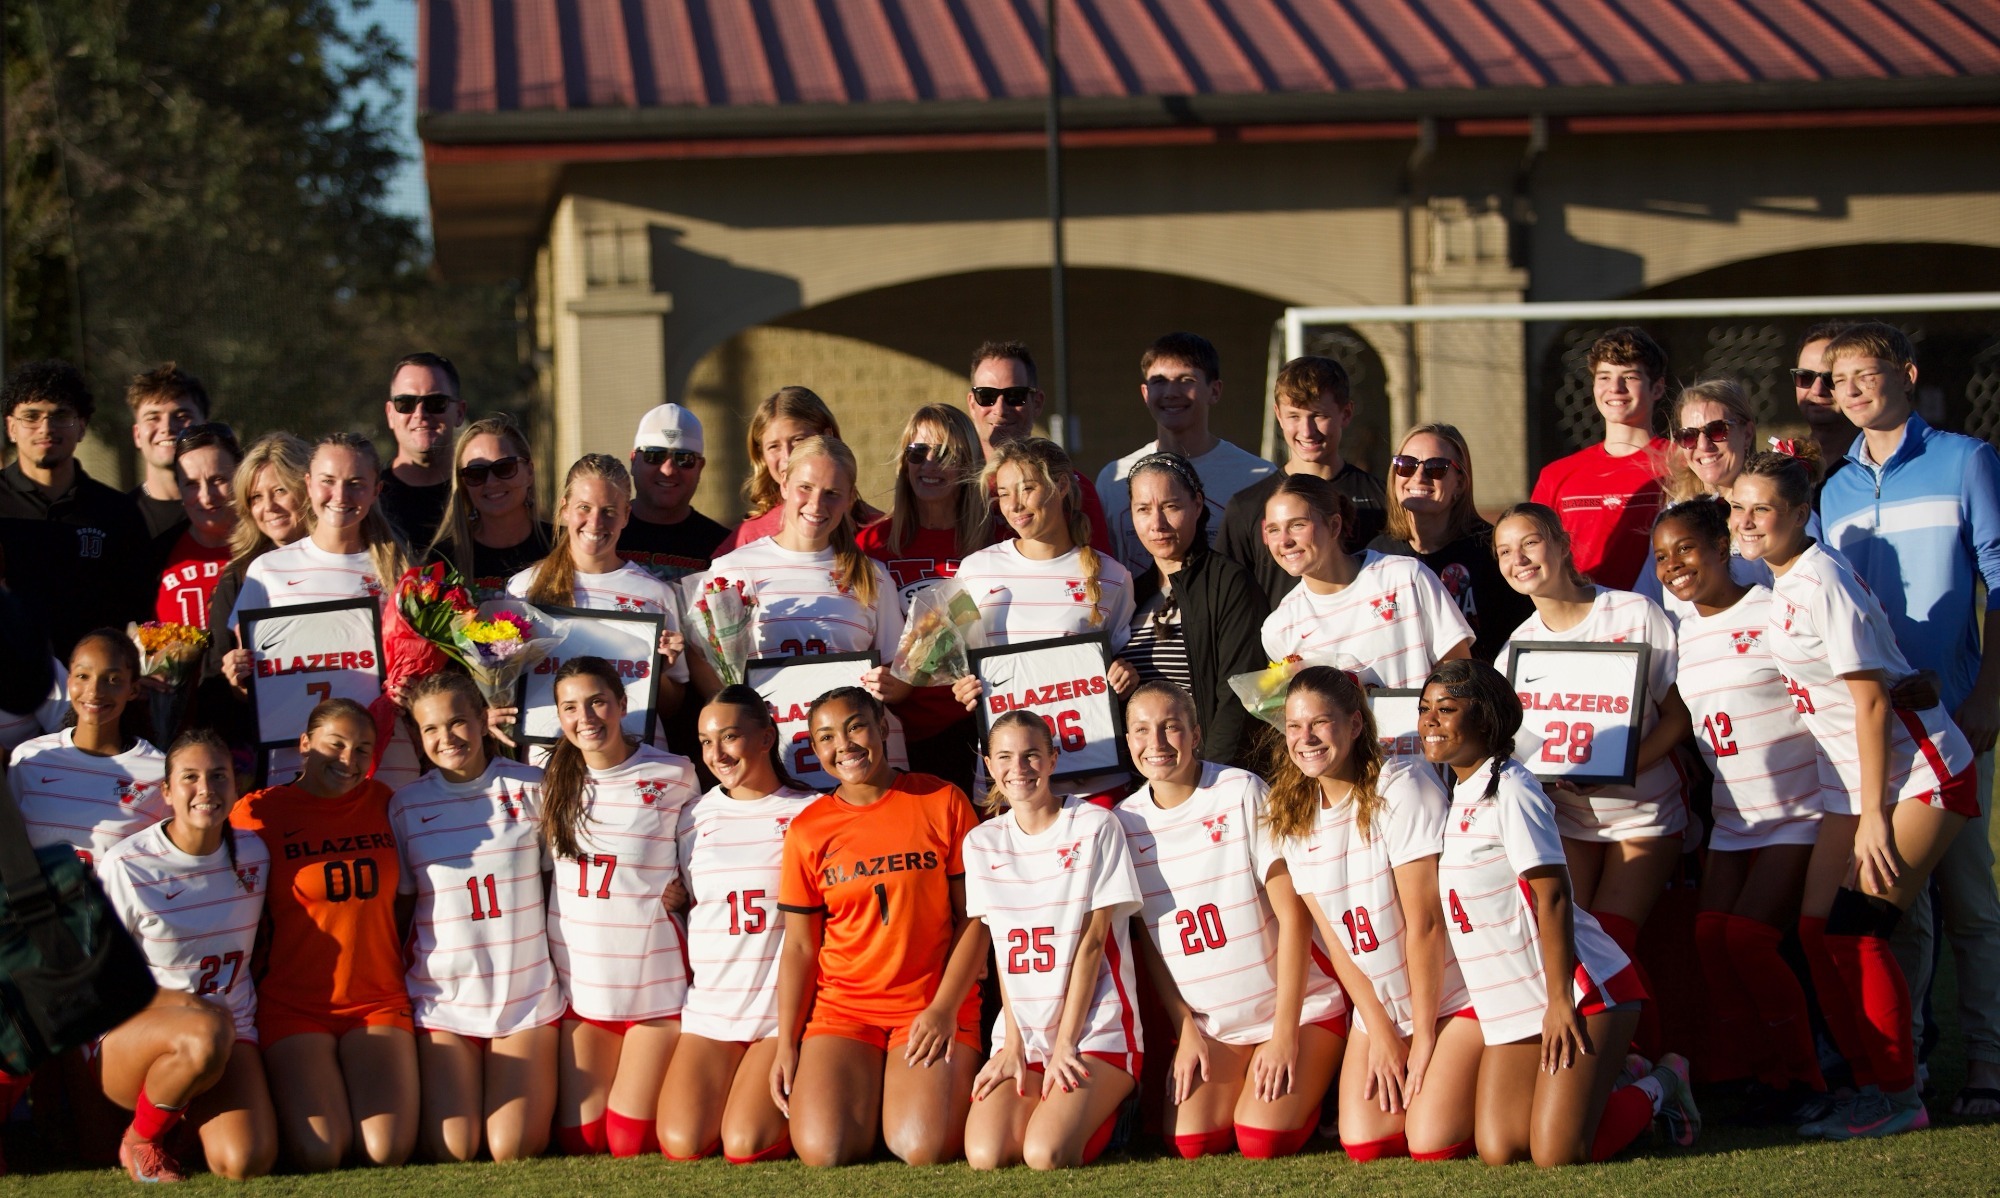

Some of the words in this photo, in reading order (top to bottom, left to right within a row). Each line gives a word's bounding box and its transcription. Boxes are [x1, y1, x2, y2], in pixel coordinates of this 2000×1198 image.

[256, 650, 376, 678] BLAZERS
[988, 676, 1107, 714] BLAZERS
[1516, 692, 1630, 714] BLAZERS
[1541, 721, 1594, 764] 28
[1705, 711, 1739, 758] 12
[641, 787, 660, 796] STATE
[284, 833, 394, 860] BLAZERS
[824, 851, 938, 886] BLAZERS
[324, 858, 379, 903] 00
[467, 874, 502, 921] 11
[577, 854, 617, 899] 17
[727, 890, 766, 935] 15
[874, 883, 889, 926] 1
[1449, 889, 1473, 934] 4
[1008, 927, 1055, 974] 25
[1175, 903, 1227, 956] 20
[1342, 906, 1379, 955] 19
[198, 951, 244, 995] 27
